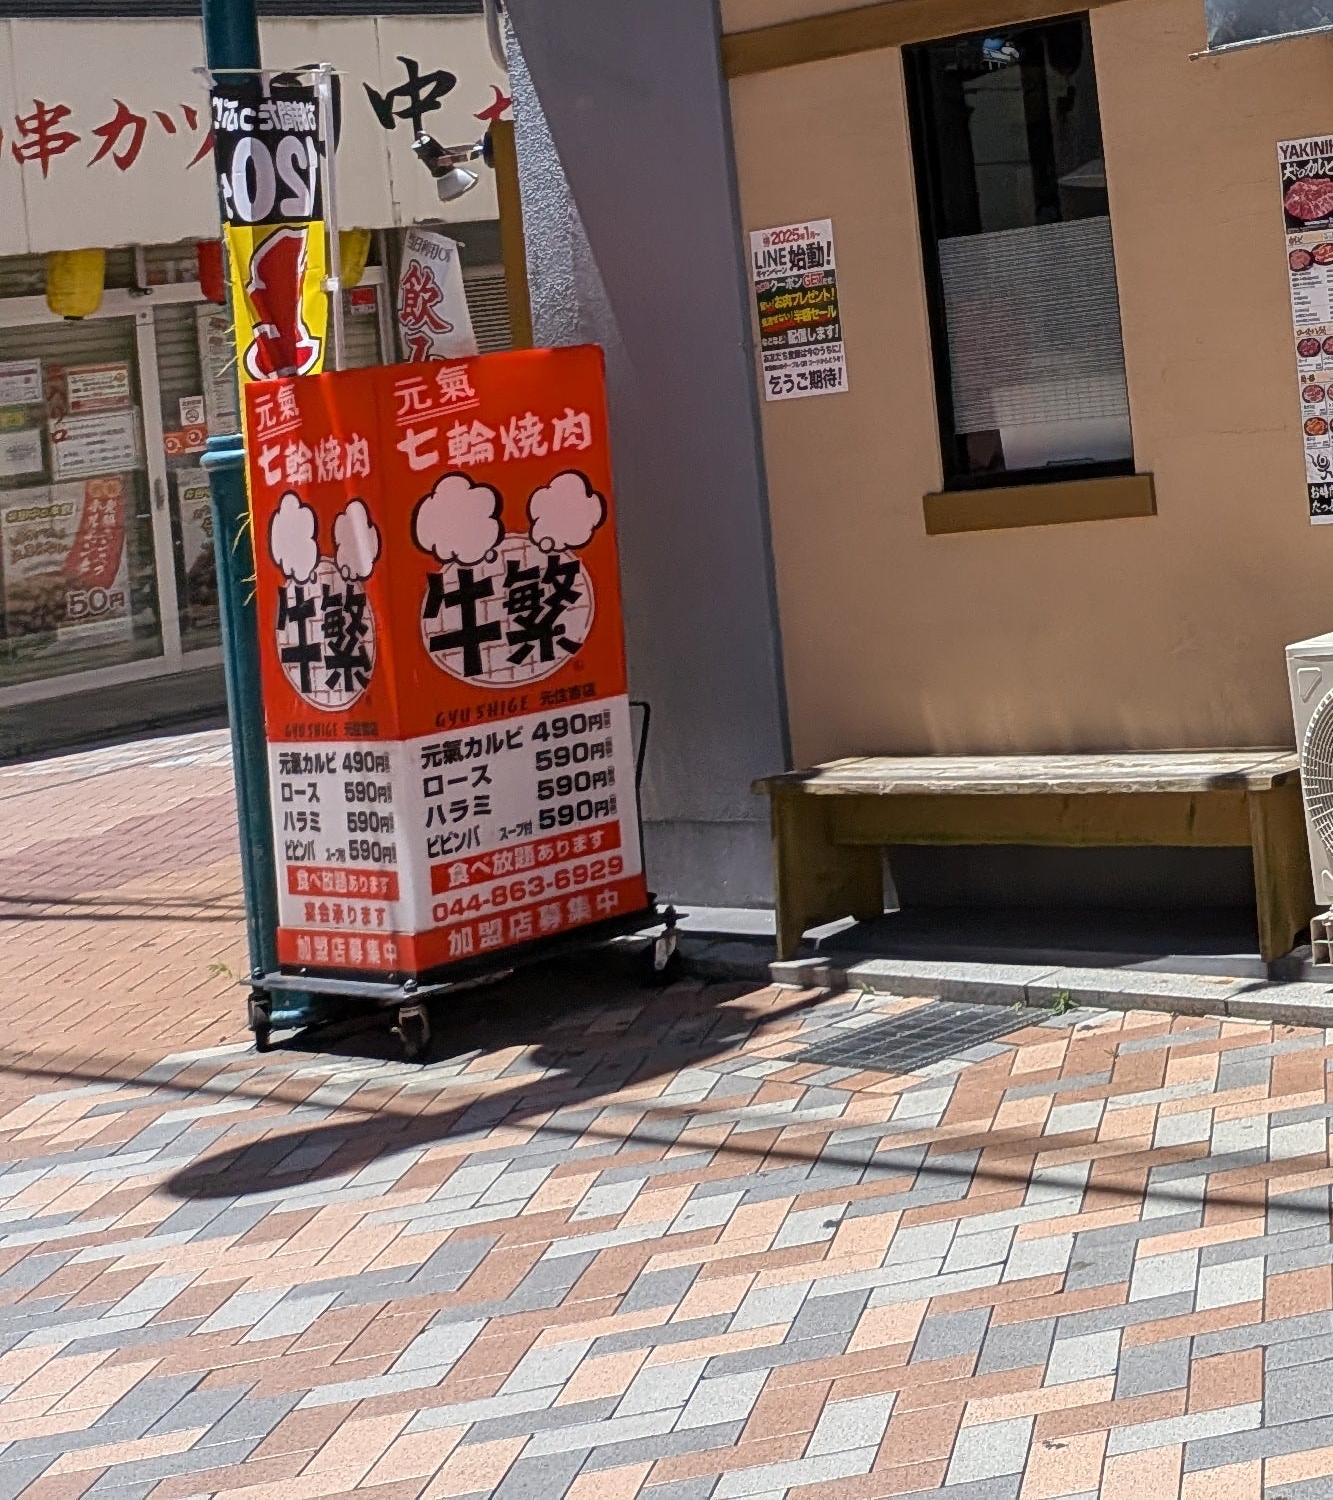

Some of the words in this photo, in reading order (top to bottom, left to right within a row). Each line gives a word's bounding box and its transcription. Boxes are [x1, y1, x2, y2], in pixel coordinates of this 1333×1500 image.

[754, 247, 787, 270] LINE
[398, 409, 593, 471] 七輪焼肉
[257, 432, 371, 486] 七輪焼肉
[422, 555, 583, 677] 牛繁
[277, 583, 372, 693] 牛繁
[435, 707, 471, 728] GYU
[476, 694, 529, 718] SHIGE
[281, 782, 320, 802] ロース
[423, 764, 492, 798] ロース
[283, 811, 321, 832] ハラミ
[425, 794, 492, 828] ハラミ
[426, 825, 481, 859] ビビンバ
[448, 829, 605, 886] 食べ放題あります
[296, 869, 389, 894] 食べ放題あります
[432, 855, 624, 922] 044-863-6929
[448, 888, 619, 956] 加盟店募集中
[297, 934, 397, 965] 加盟店募集中
